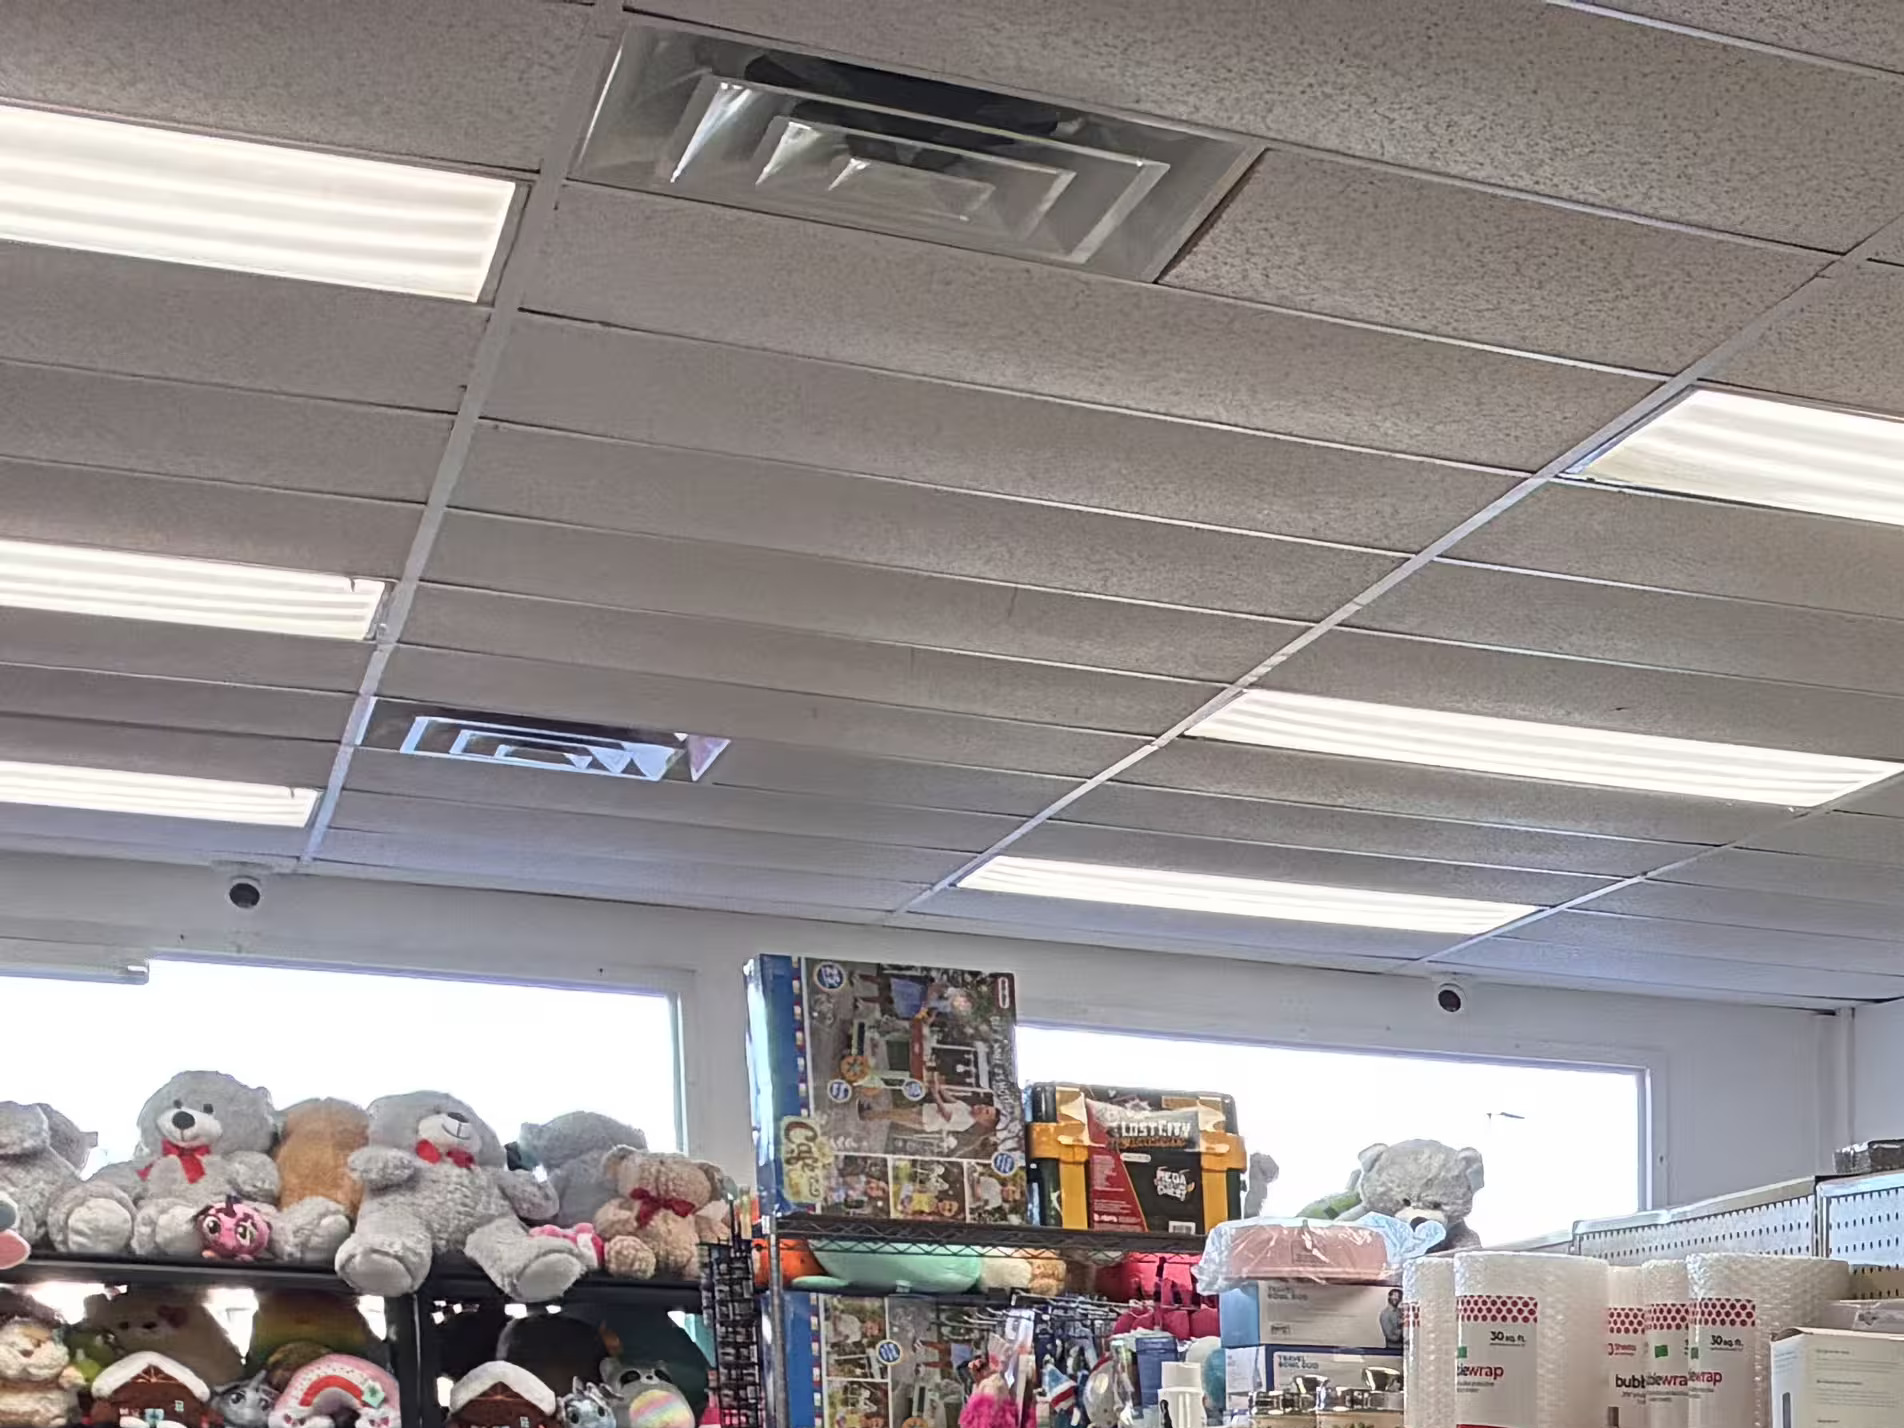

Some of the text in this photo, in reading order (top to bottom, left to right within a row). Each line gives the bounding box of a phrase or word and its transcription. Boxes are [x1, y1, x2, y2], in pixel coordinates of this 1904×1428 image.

[1121, 1121, 1158, 1138] LOST
[1490, 1330, 1504, 1343] 30
[1710, 1334, 1723, 1346] 30
